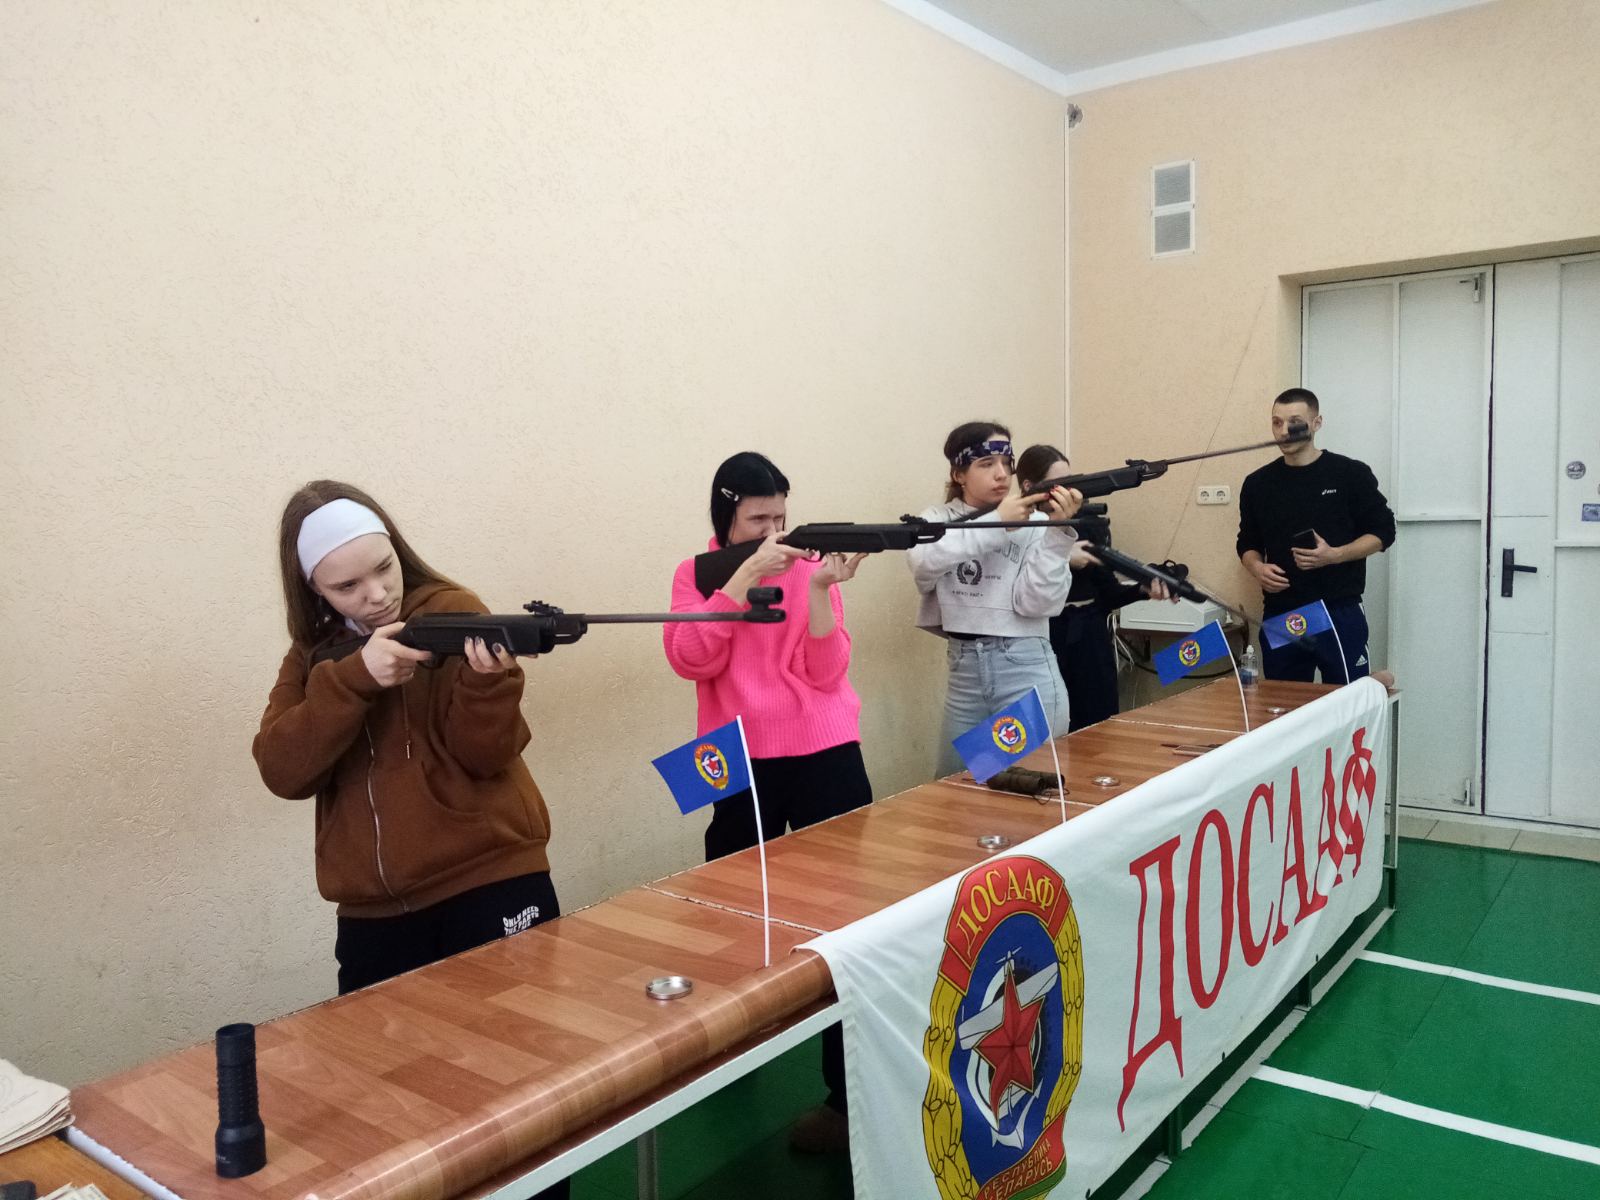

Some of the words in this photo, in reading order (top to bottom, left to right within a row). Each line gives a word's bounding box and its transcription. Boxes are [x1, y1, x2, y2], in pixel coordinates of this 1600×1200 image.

[503, 912, 521, 928] ONLY
[956, 866, 1055, 959] ДОСААФ
[1117, 727, 1377, 1133] ДОСААФ
[984, 1138, 1051, 1199] РЕСПУБЛИКА
[989, 1156, 1053, 1200] ЕЛАРУСЬ
